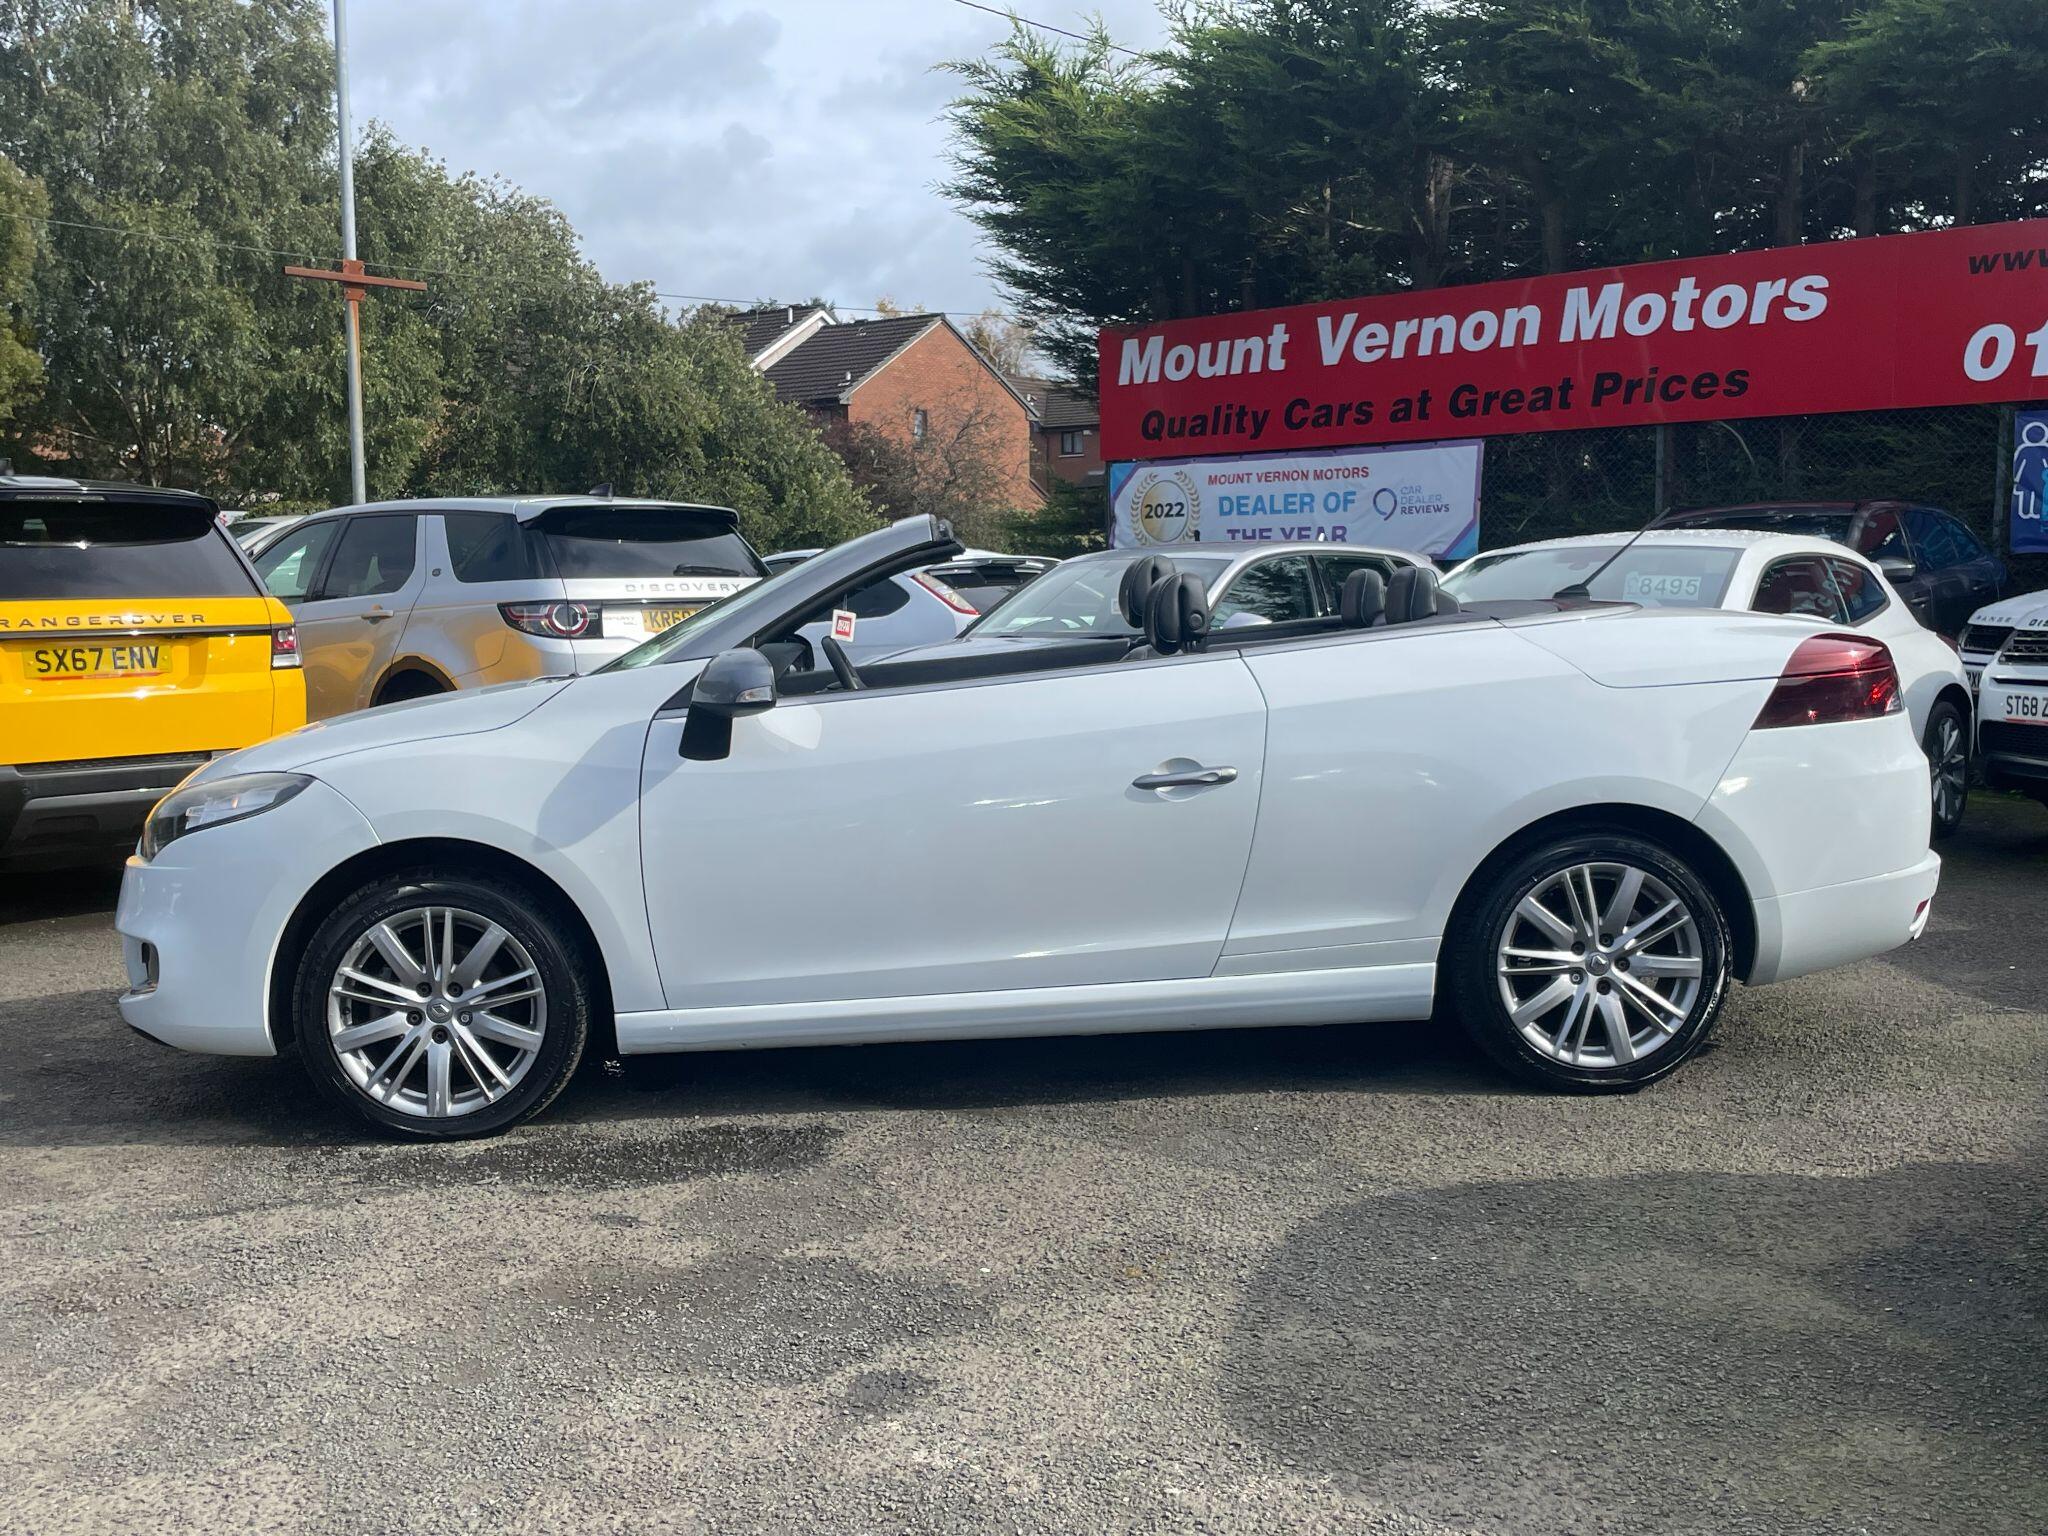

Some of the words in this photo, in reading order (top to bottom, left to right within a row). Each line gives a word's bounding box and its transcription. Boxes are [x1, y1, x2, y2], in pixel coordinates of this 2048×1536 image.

[1118, 323, 1290, 386] Mount
[1317, 304, 1542, 367] Vernon
[1558, 274, 1830, 344] Motors
[1141, 402, 1271, 441] Quality
[1284, 398, 1374, 431] Cars
[1389, 389, 1432, 423] at
[1449, 377, 1574, 419] Great
[1591, 367, 1750, 408] Prices
[1207, 473, 1253, 486] MOUNT
[1257, 470, 1309, 483] VERNON
[1313, 466, 1370, 480] MOTORS
[1144, 501, 1185, 520] 2022
[1218, 493, 1315, 517] DEALER
[1322, 491, 1357, 514] OF
[1400, 504, 1450, 515] REVIEWS
[625, 583, 741, 593] DISCOVERY
[35, 648, 104, 673] SX67
[112, 645, 159, 670] ENV
[2006, 695, 2038, 717] ST68
